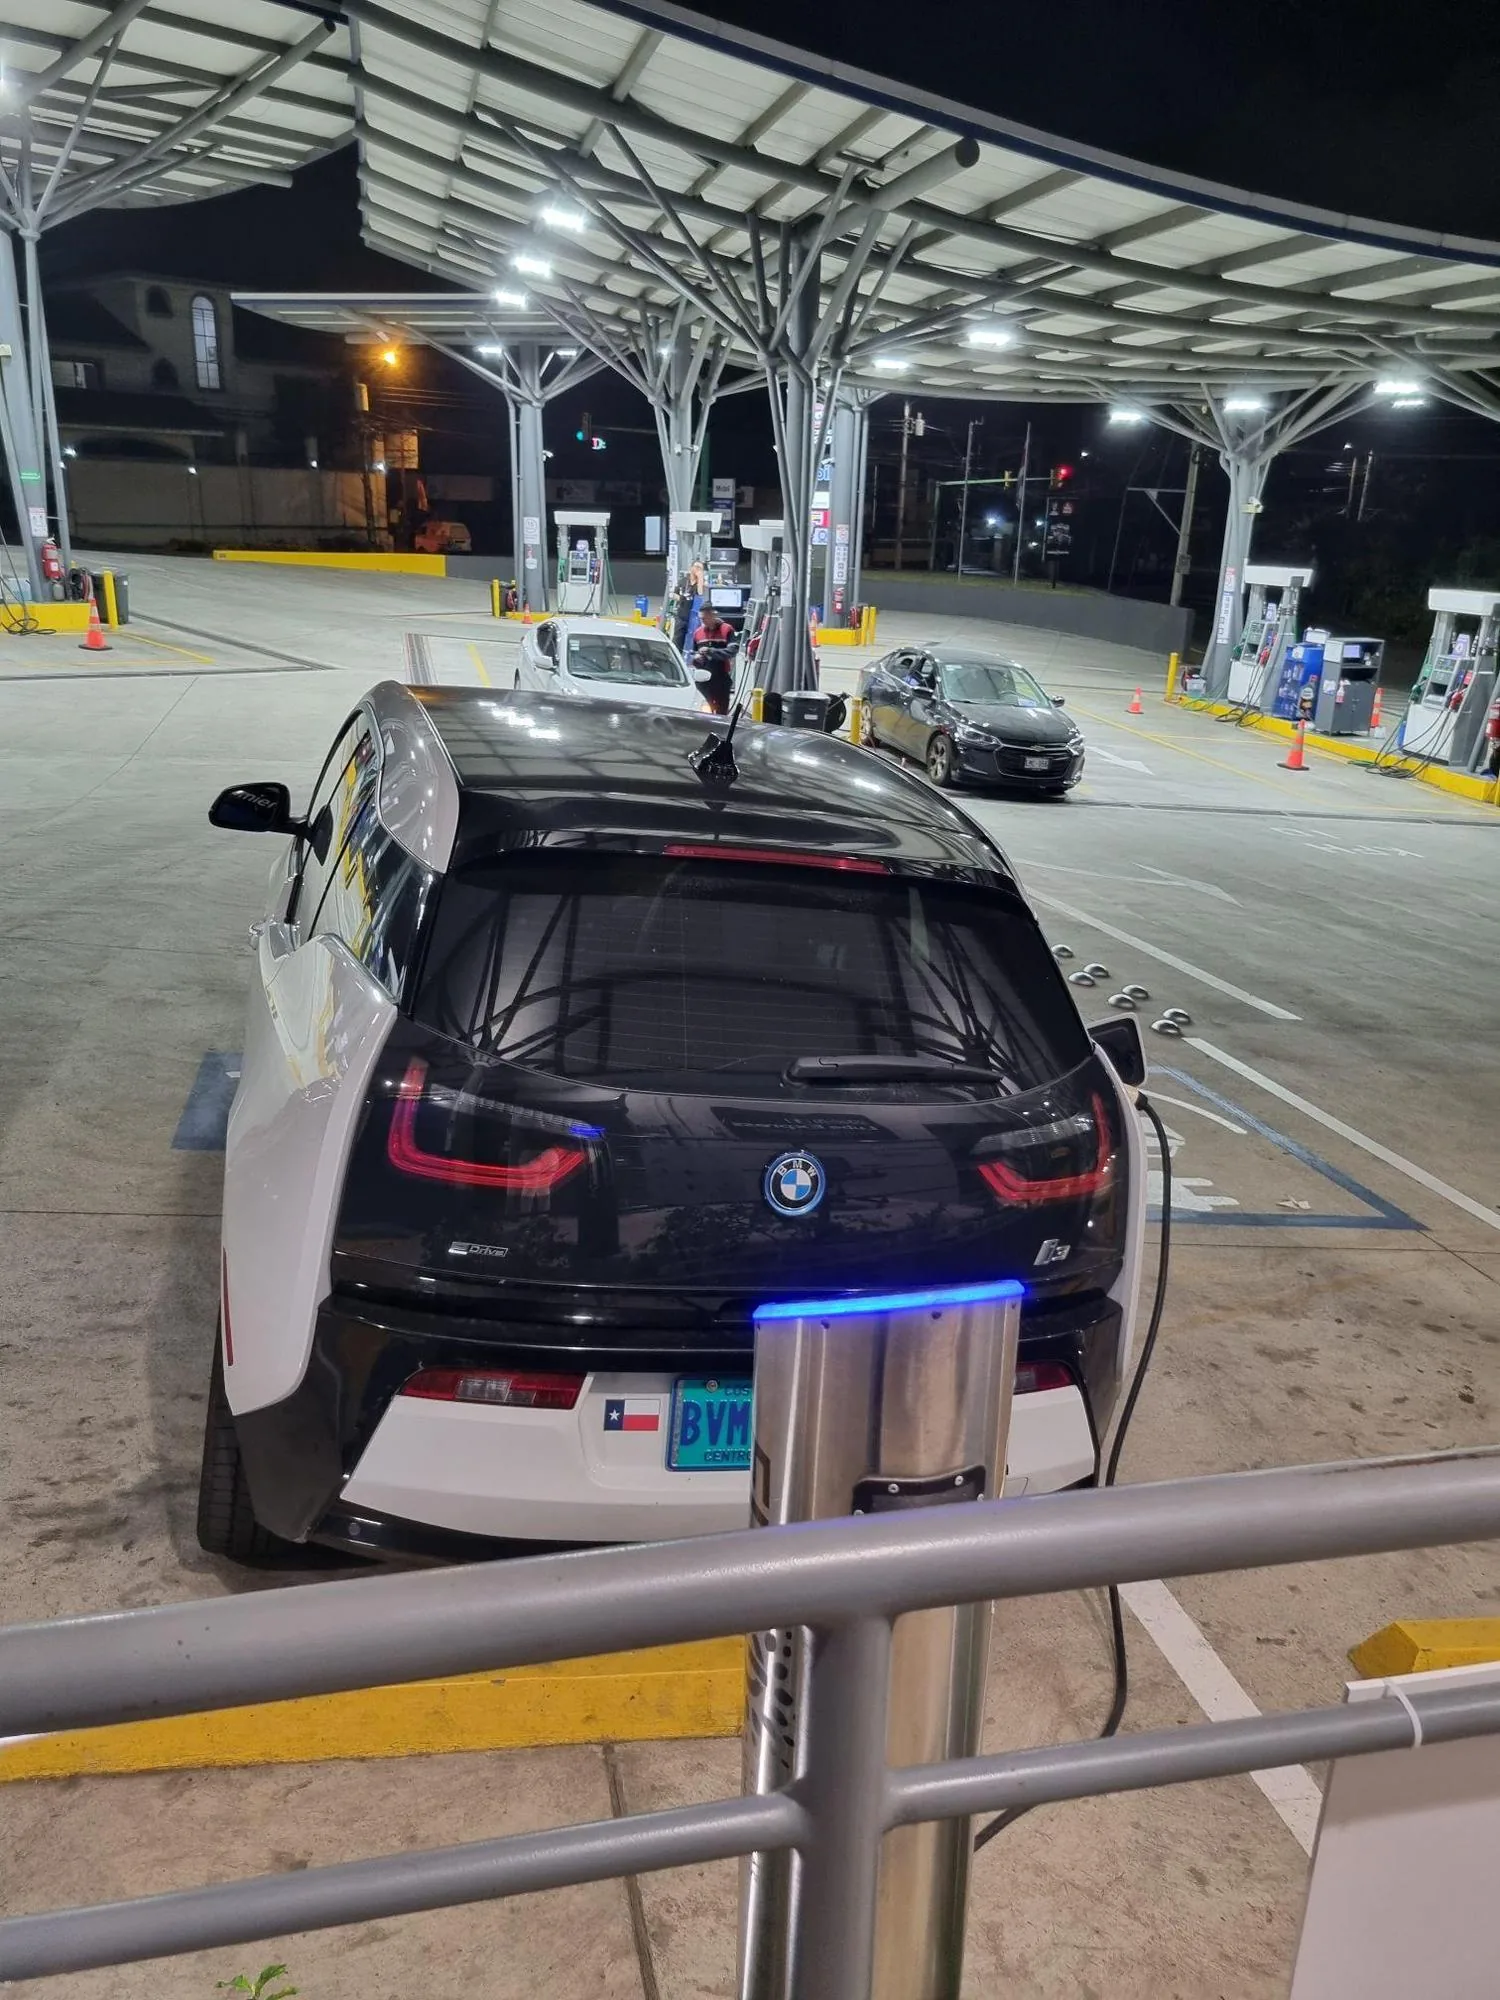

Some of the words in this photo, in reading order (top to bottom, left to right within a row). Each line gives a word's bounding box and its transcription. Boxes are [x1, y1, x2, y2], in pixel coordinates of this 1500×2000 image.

[777, 1160, 817, 1177] BMW
[1033, 1238, 1071, 1266] i3
[724, 1385, 751, 1397] COS
[680, 1399, 751, 1447] BVM
